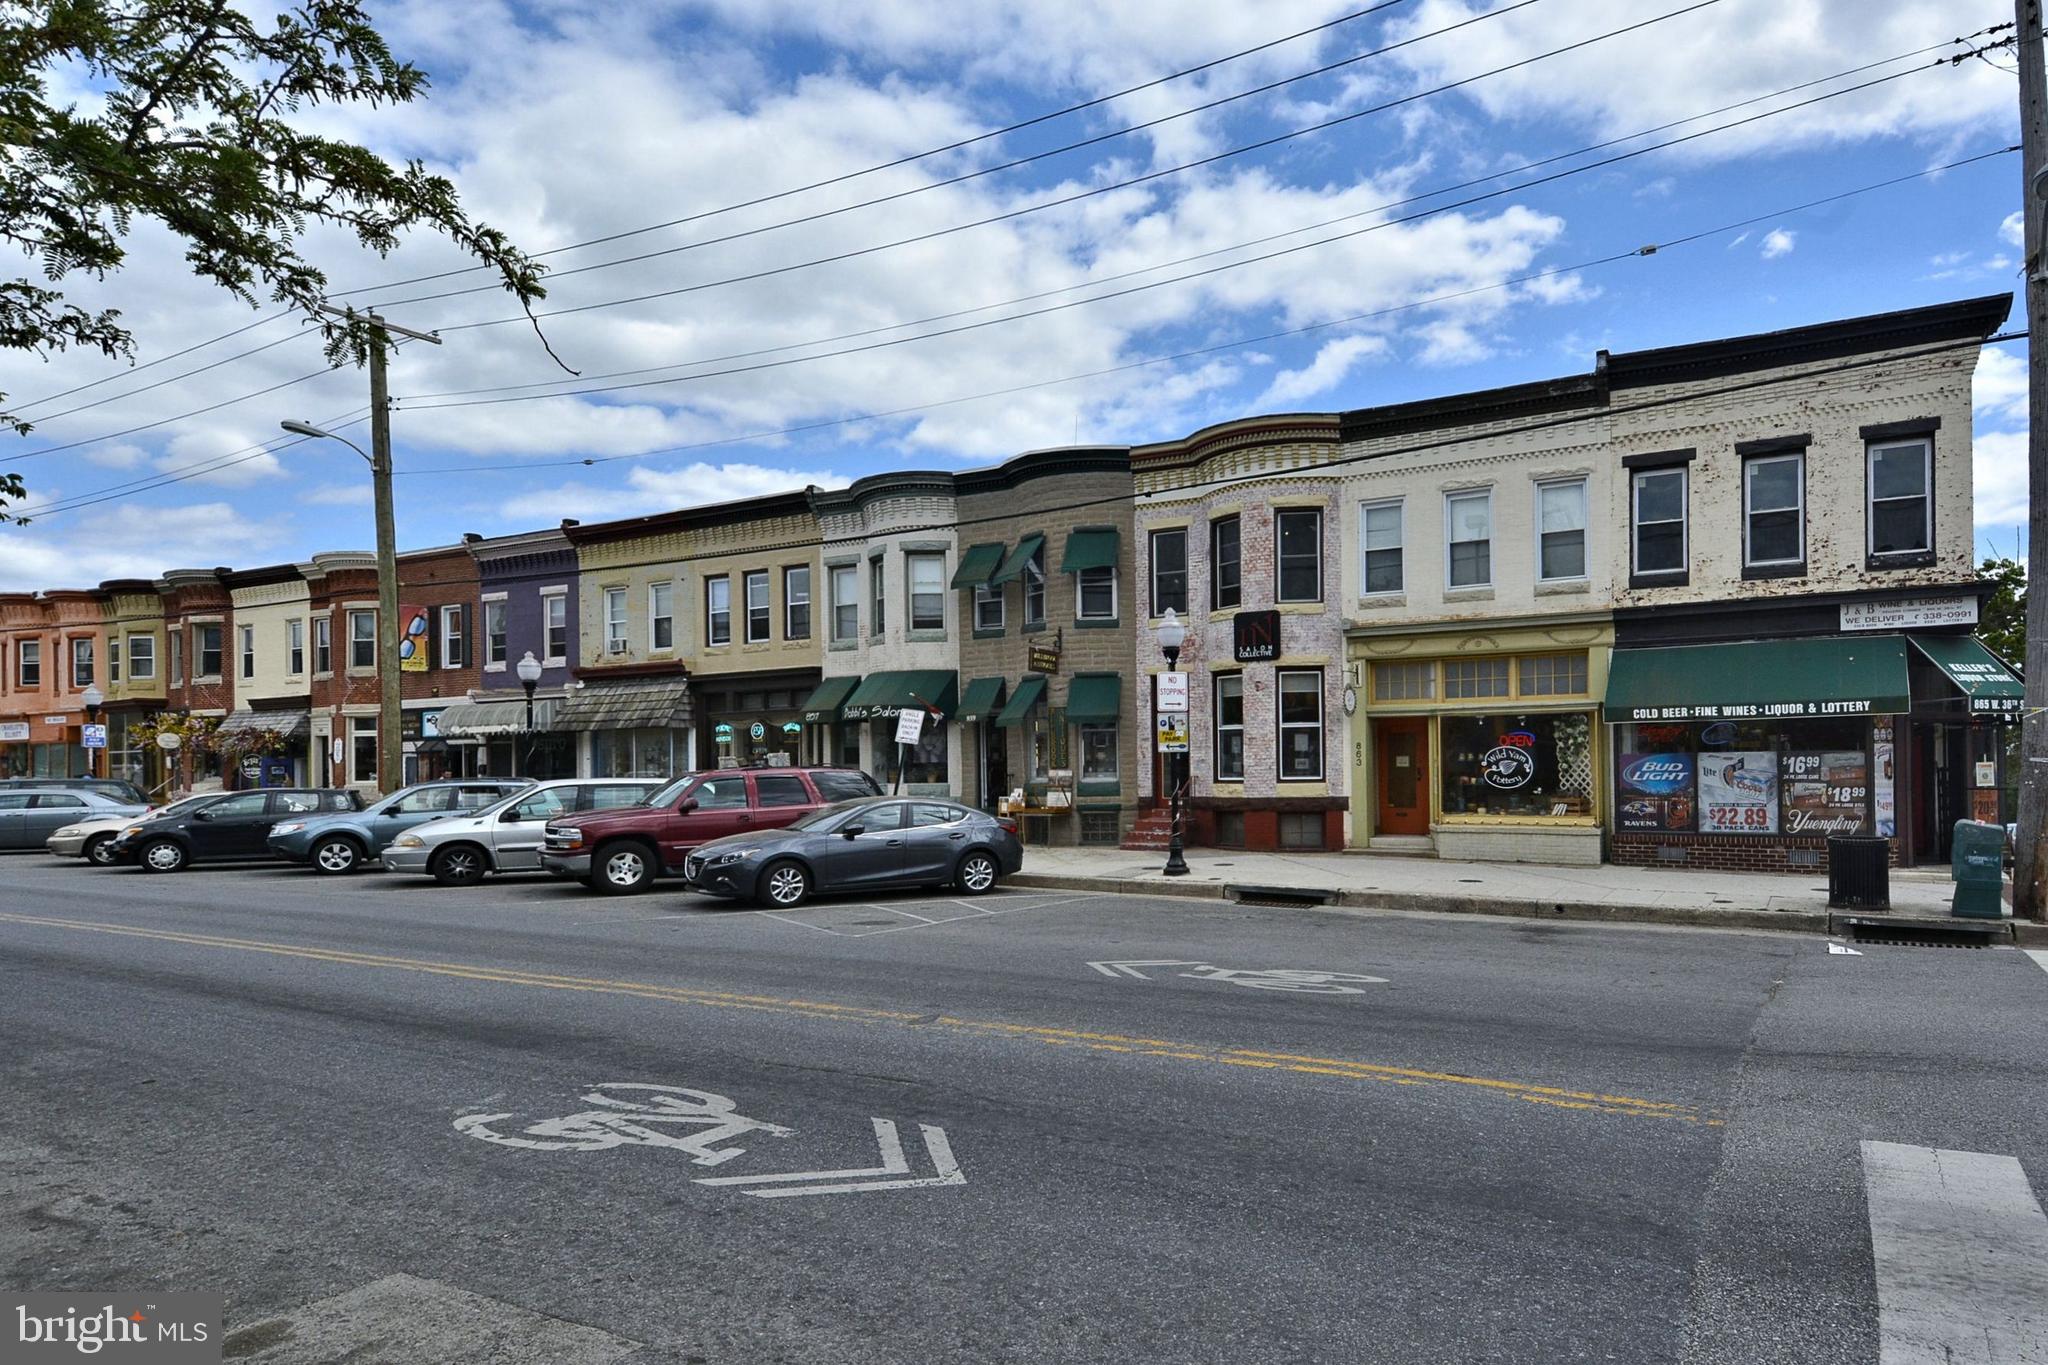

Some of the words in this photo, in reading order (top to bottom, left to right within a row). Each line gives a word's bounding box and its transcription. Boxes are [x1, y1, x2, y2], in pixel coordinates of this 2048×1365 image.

[1867, 603, 1875, 614] B
[1879, 600, 1903, 608] WINE
[1919, 597, 1963, 607] LIQUORS
[1865, 615, 1905, 623] DELIVER
[1923, 611, 1972, 620] 338-0991
[1239, 644, 1273, 652] SALON
[1239, 650, 1273, 658] COLLECTIVE
[1168, 676, 1177, 684] NO
[1160, 687, 1185, 696] STOPPING
[1633, 708, 1658, 719] COLD
[1662, 707, 1688, 718] BEER
[1695, 706, 1718, 717] FINE
[1723, 705, 1757, 717] WINES
[1765, 703, 1804, 715] LIQUOR
[1808, 703, 1817, 713] &
[1822, 701, 1871, 713] LOTTERY
[1974, 699, 1989, 710] 865
[1991, 699, 2000, 710] W.
[871, 705, 903, 717] Salon
[1499, 735, 1533, 747] OPEN
[1487, 748, 1507, 763] Wild
[1508, 750, 1527, 763] Yam
[1641, 761, 1684, 771] BUD
[1632, 772, 1689, 781] LIGHT
[1703, 767, 1718, 777] Lite
[1492, 774, 1523, 785] Pottery
[1709, 807, 1768, 826] $22.89
[1785, 809, 1864, 835] Yuengling
